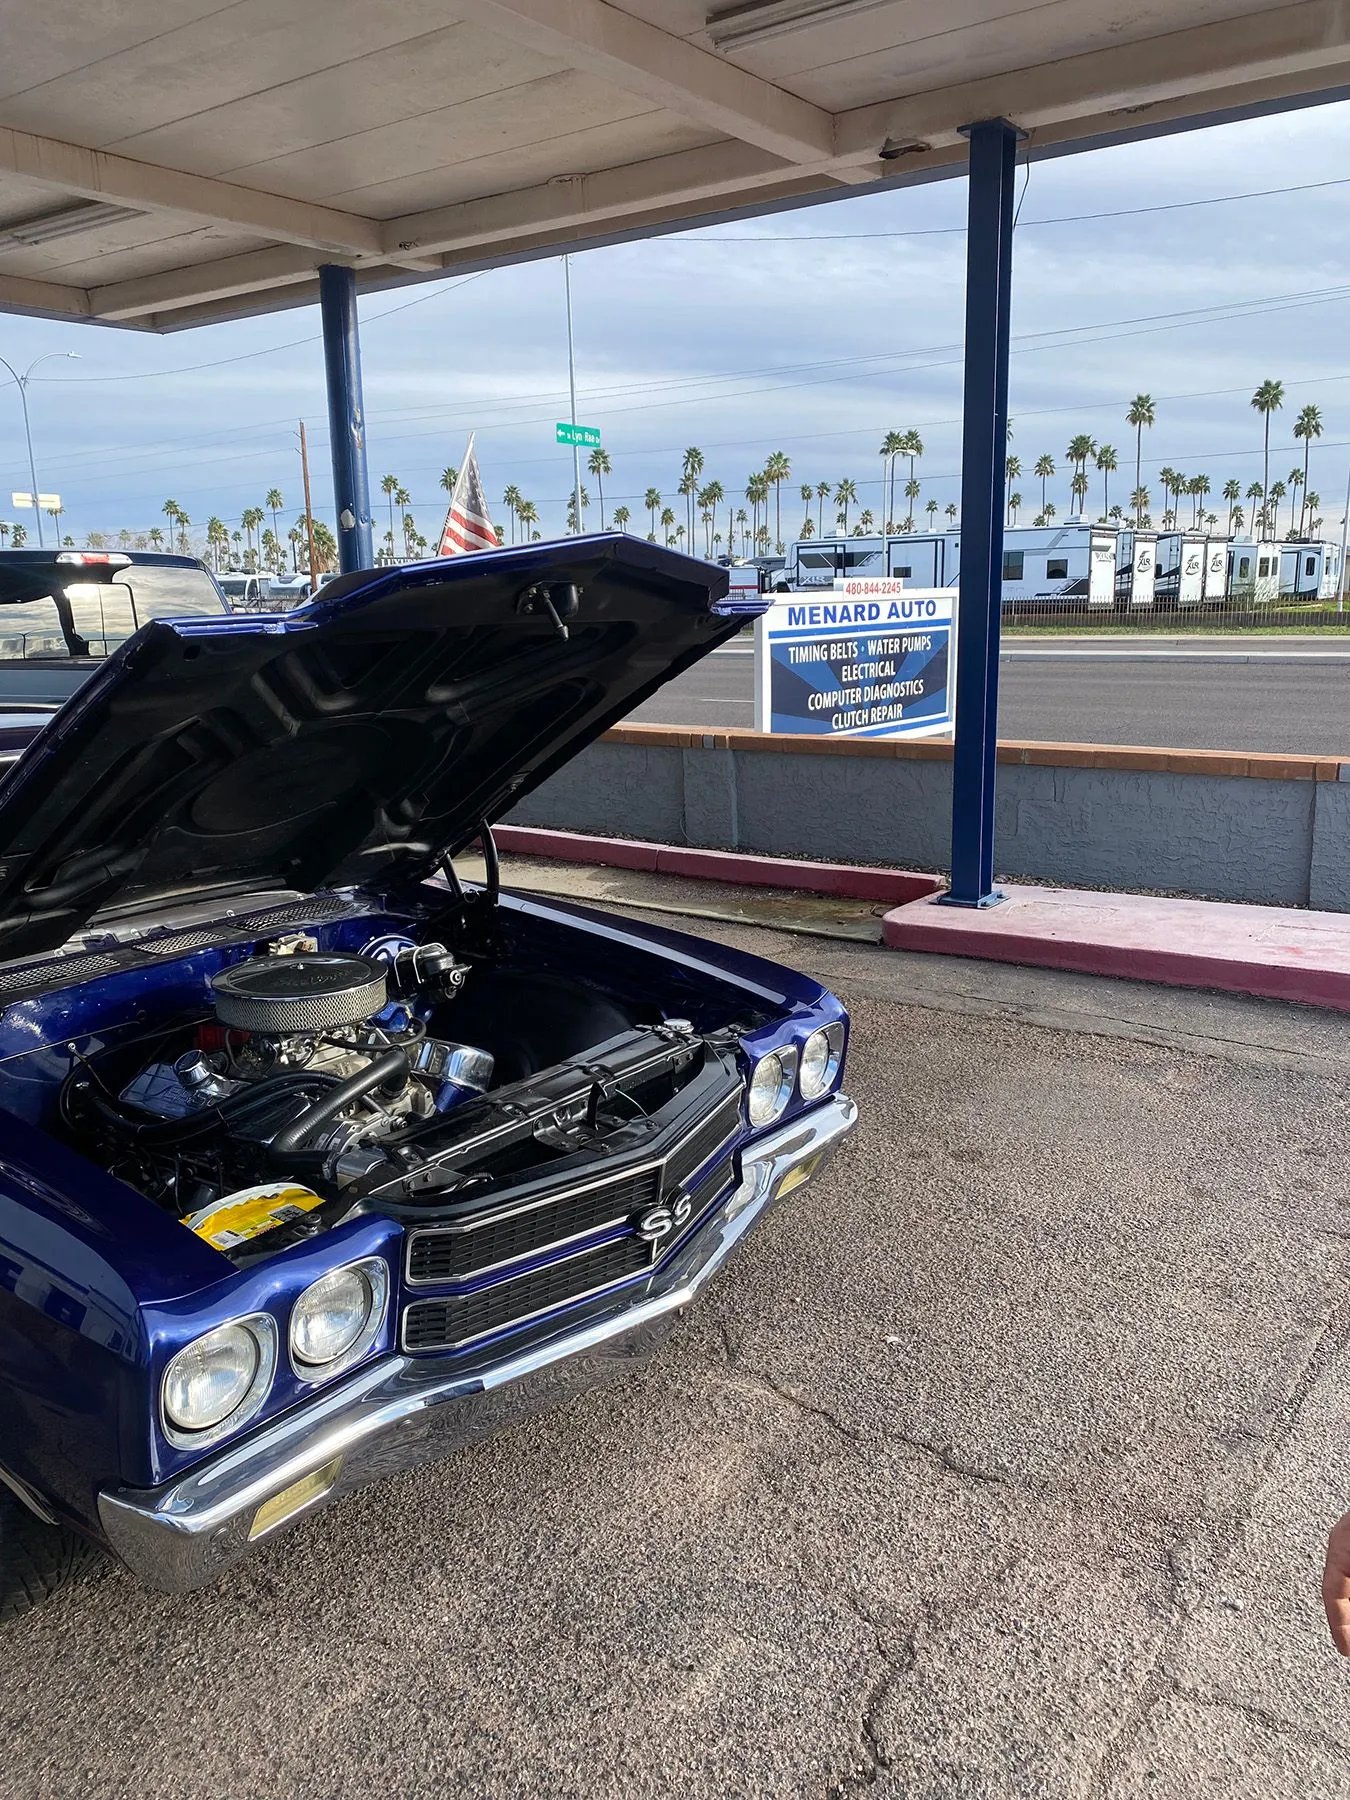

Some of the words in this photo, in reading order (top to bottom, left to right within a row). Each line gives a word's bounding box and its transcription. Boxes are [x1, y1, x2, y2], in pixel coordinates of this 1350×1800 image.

[845, 581, 901, 595] 480-844-2245
[788, 603, 881, 626] MENARD
[887, 599, 937, 619] AUTO
[788, 645, 828, 664] TIMING
[830, 641, 859, 660] BELTS
[867, 637, 901, 656] WATER
[902, 635, 932, 652] PUMPS
[842, 661, 896, 682] ELECTRICAL
[808, 688, 862, 711] COMPUTER
[864, 679, 924, 701] DIAGNOSTICS
[832, 709, 869, 730] CLUTCH
[870, 703, 903, 724] REPAIR
[640, 1193, 692, 1241] SS
